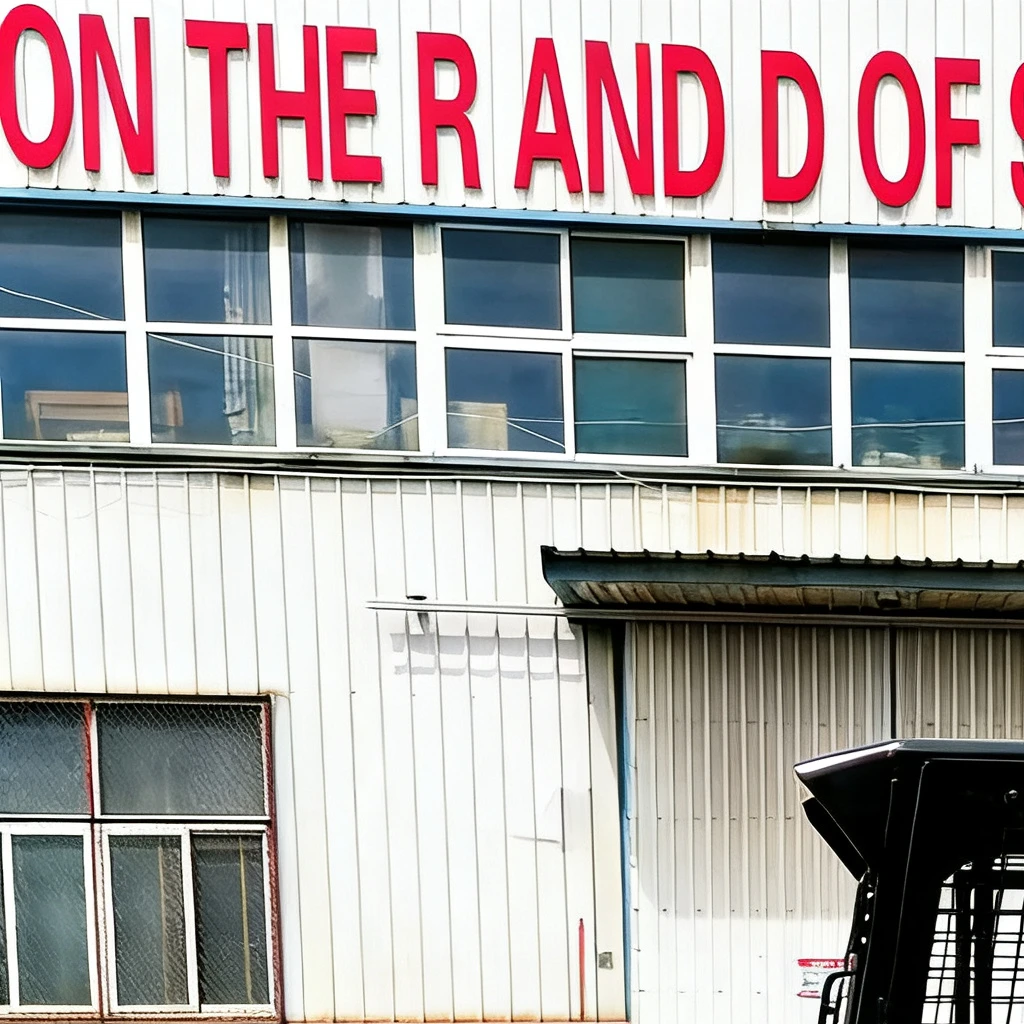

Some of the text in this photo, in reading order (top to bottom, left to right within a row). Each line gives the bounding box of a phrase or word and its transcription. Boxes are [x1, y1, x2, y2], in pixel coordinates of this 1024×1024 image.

[0, 4, 155, 174] ON
[185, 20, 383, 182] THE
[417, 32, 481, 189] R
[514, 38, 726, 198] AND
[761, 50, 825, 203] D
[858, 51, 981, 208] OF
